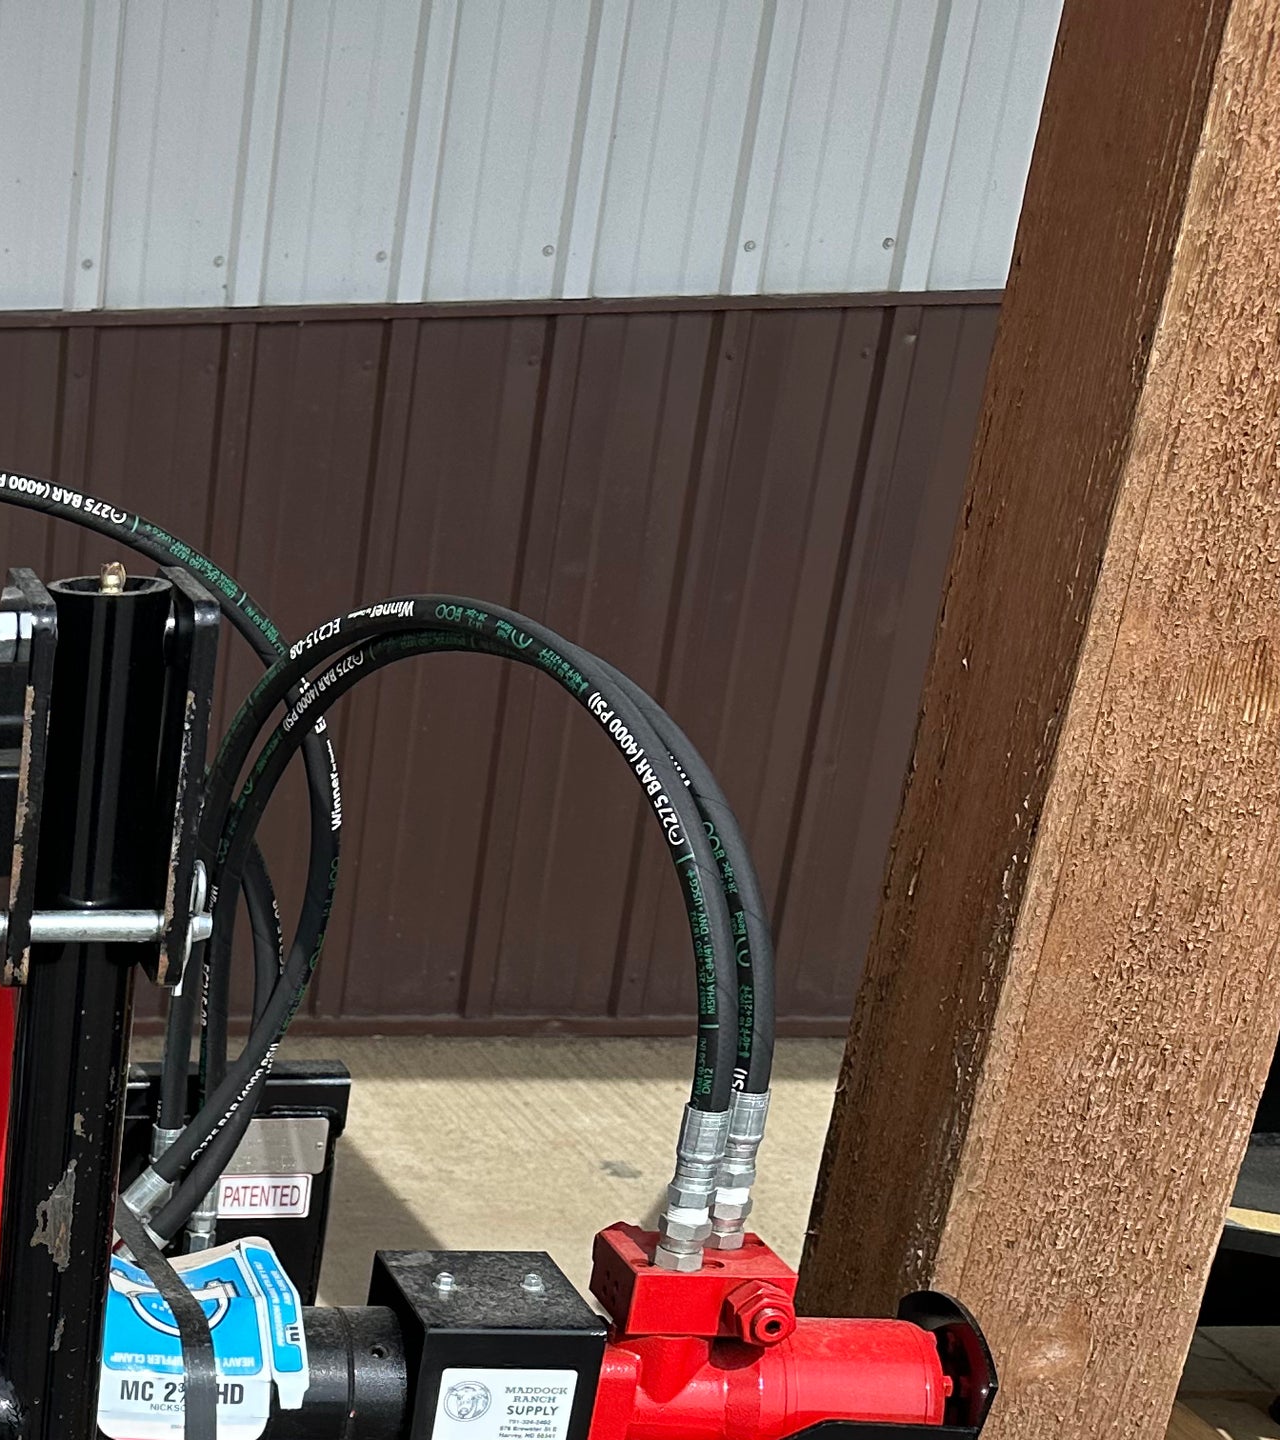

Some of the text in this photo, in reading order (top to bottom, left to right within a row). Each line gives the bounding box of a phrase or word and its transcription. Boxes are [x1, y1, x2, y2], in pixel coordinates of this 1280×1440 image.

[8, 475, 51, 500] (4000
[52, 486, 85, 508] BAR
[83, 498, 119, 521] 275
[290, 600, 415, 660] Winner EC215-08
[335, 656, 355, 677] 275
[318, 669, 338, 692] BAR
[296, 683, 320, 714] (4000
[587, 691, 680, 828] 275 BAR (4000 PSI)
[329, 772, 342, 832] Winner
[731, 1068, 749, 1093] SI)
[222, 1185, 301, 1208] PATENTED
[223, 1356, 255, 1368] HEAVY
[120, 1379, 154, 1402] MC
[504, 1386, 568, 1395] MADDOCK
[513, 1395, 557, 1404] RANCH
[506, 1405, 559, 1416] SUPPLY
